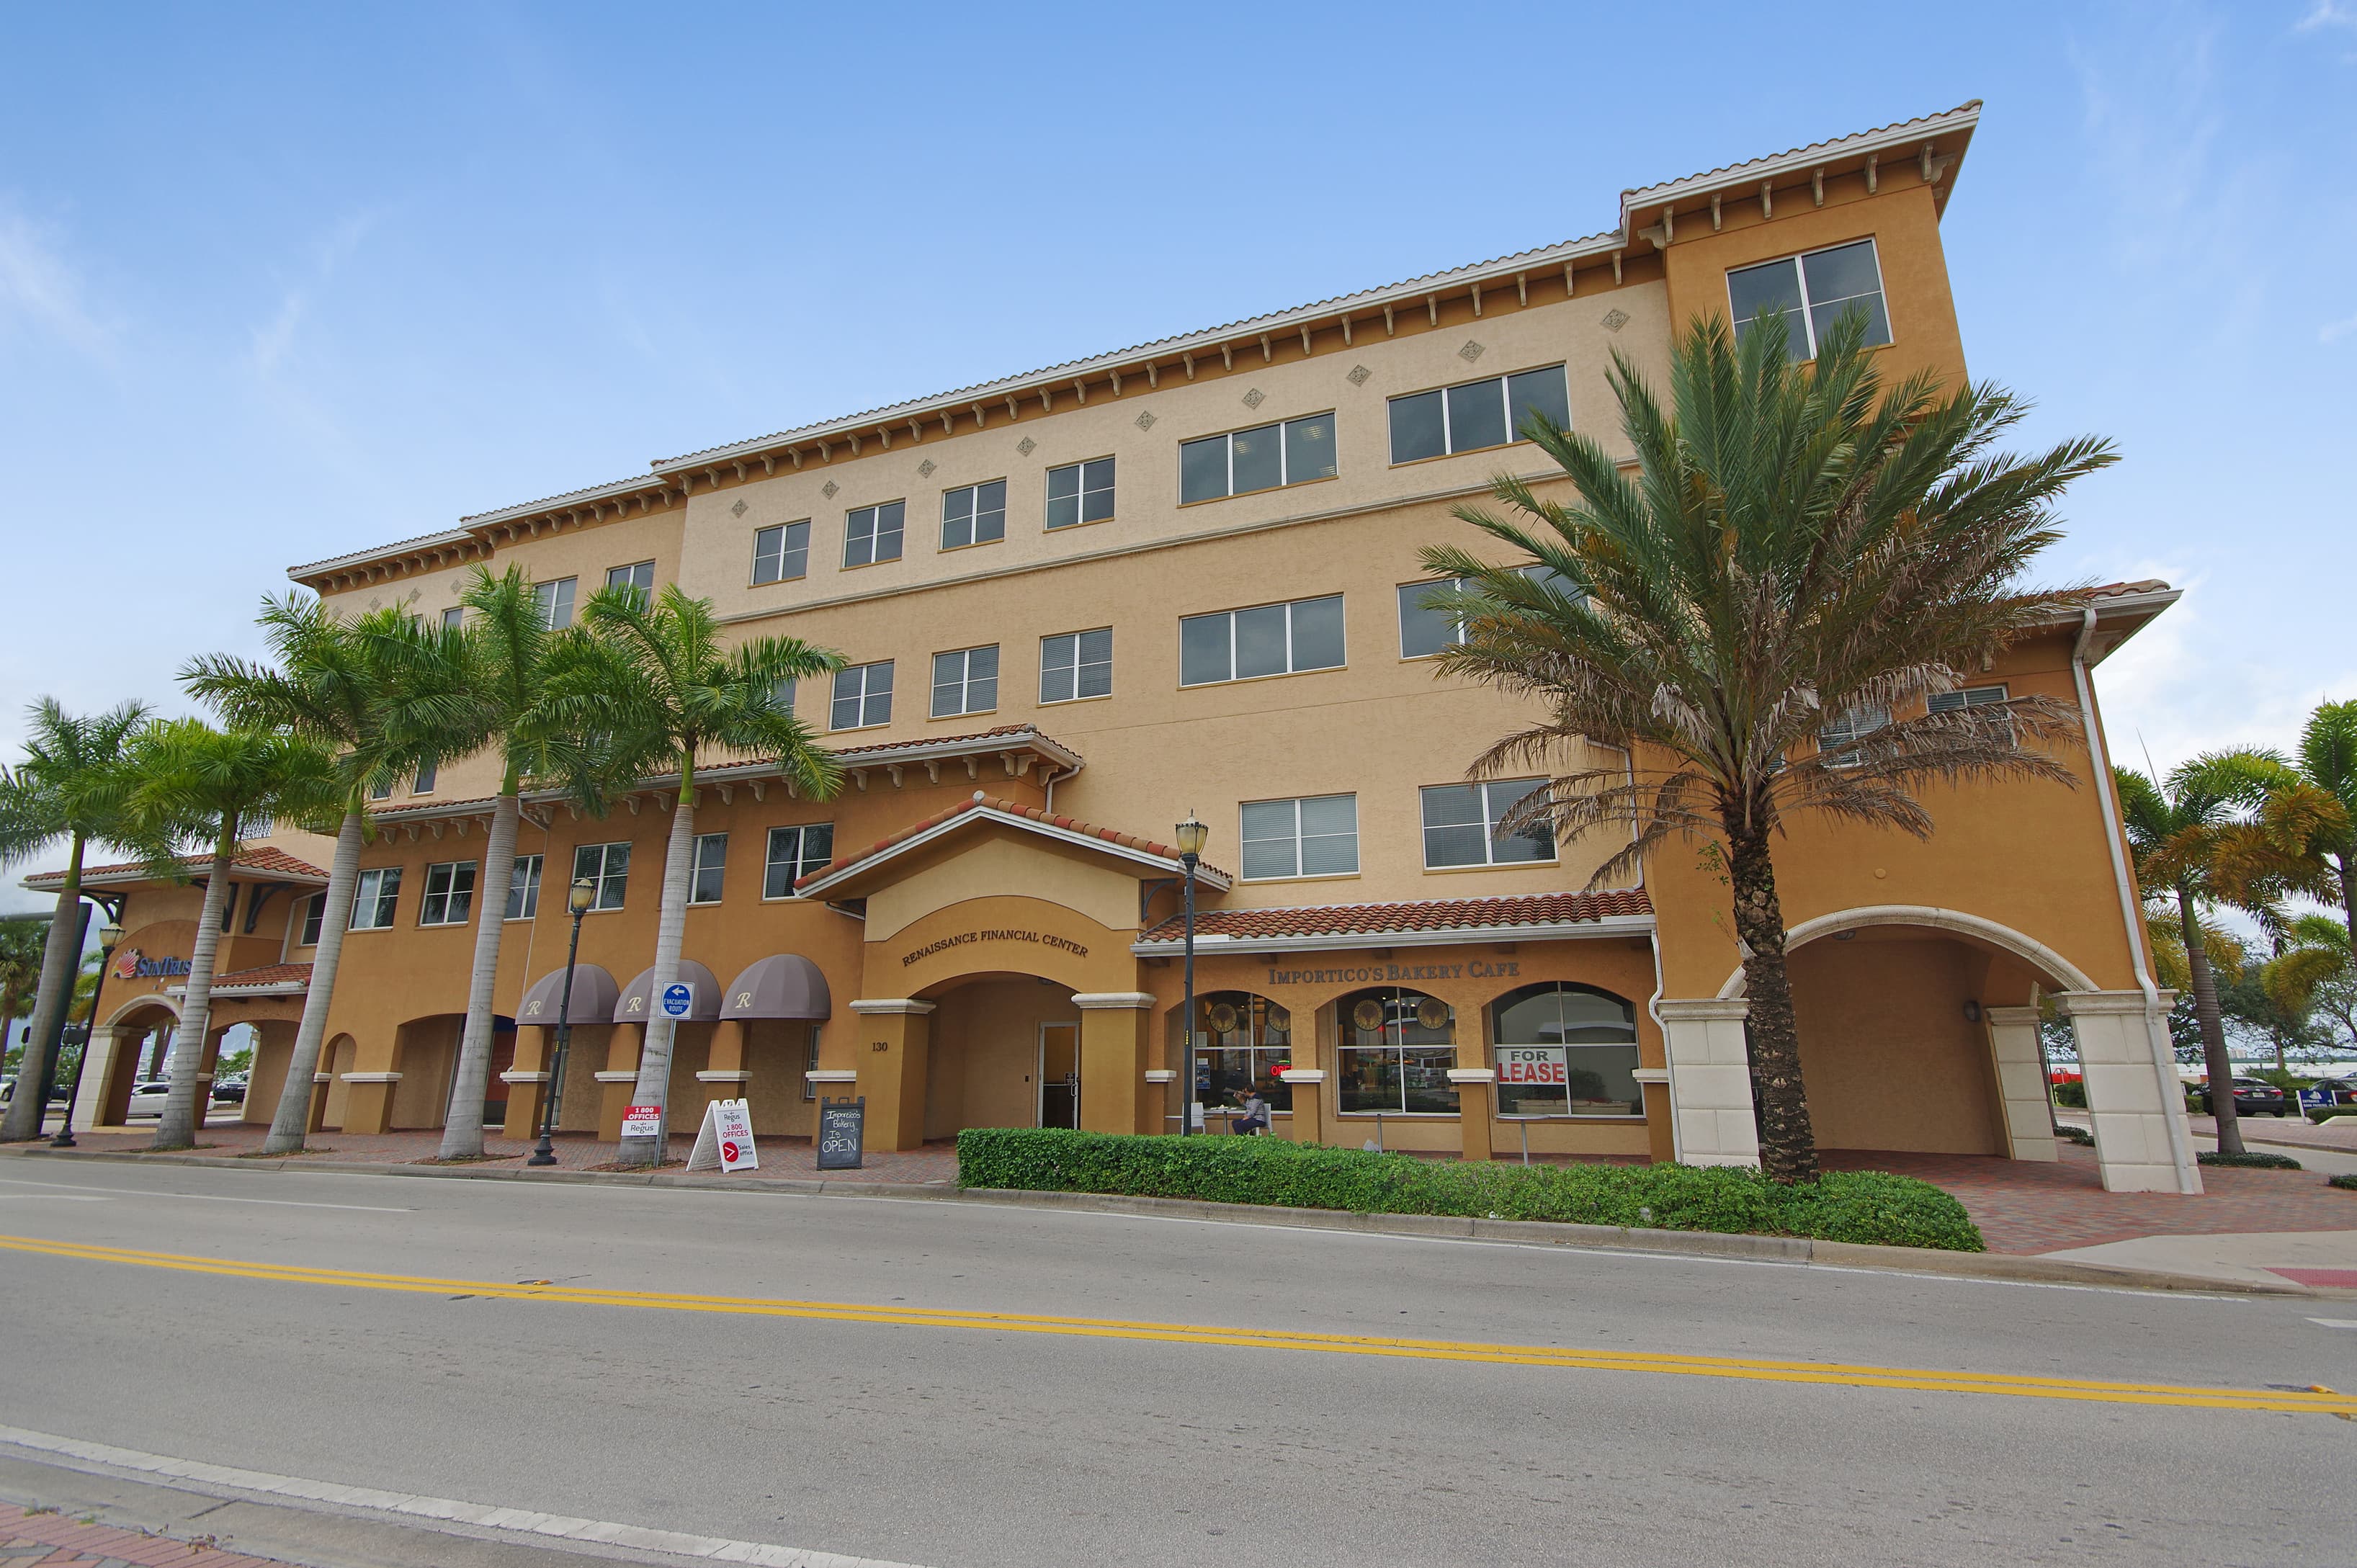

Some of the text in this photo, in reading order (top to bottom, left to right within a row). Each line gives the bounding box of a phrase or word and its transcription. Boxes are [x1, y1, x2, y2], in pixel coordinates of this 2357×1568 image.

[902, 929, 1088, 967] RENAISSANCE FINANCIAL CENTER
[136, 956, 192, 977] SUNTRUS
[1269, 960, 1520, 985] IMPORTICO'S BAKERY CAFE
[626, 996, 642, 1013] R
[663, 998, 689, 1006] EVACUATION
[735, 992, 751, 1008] R
[526, 1000, 541, 1016] R
[872, 1041, 888, 1052] 130
[1511, 1050, 1549, 1062] FOR
[1498, 1062, 1565, 1083] LEASE
[724, 1114, 741, 1122] Regus
[630, 1124, 654, 1134] Regus
[723, 1129, 748, 1138] OFFICES
[822, 1138, 857, 1153] OPEN
